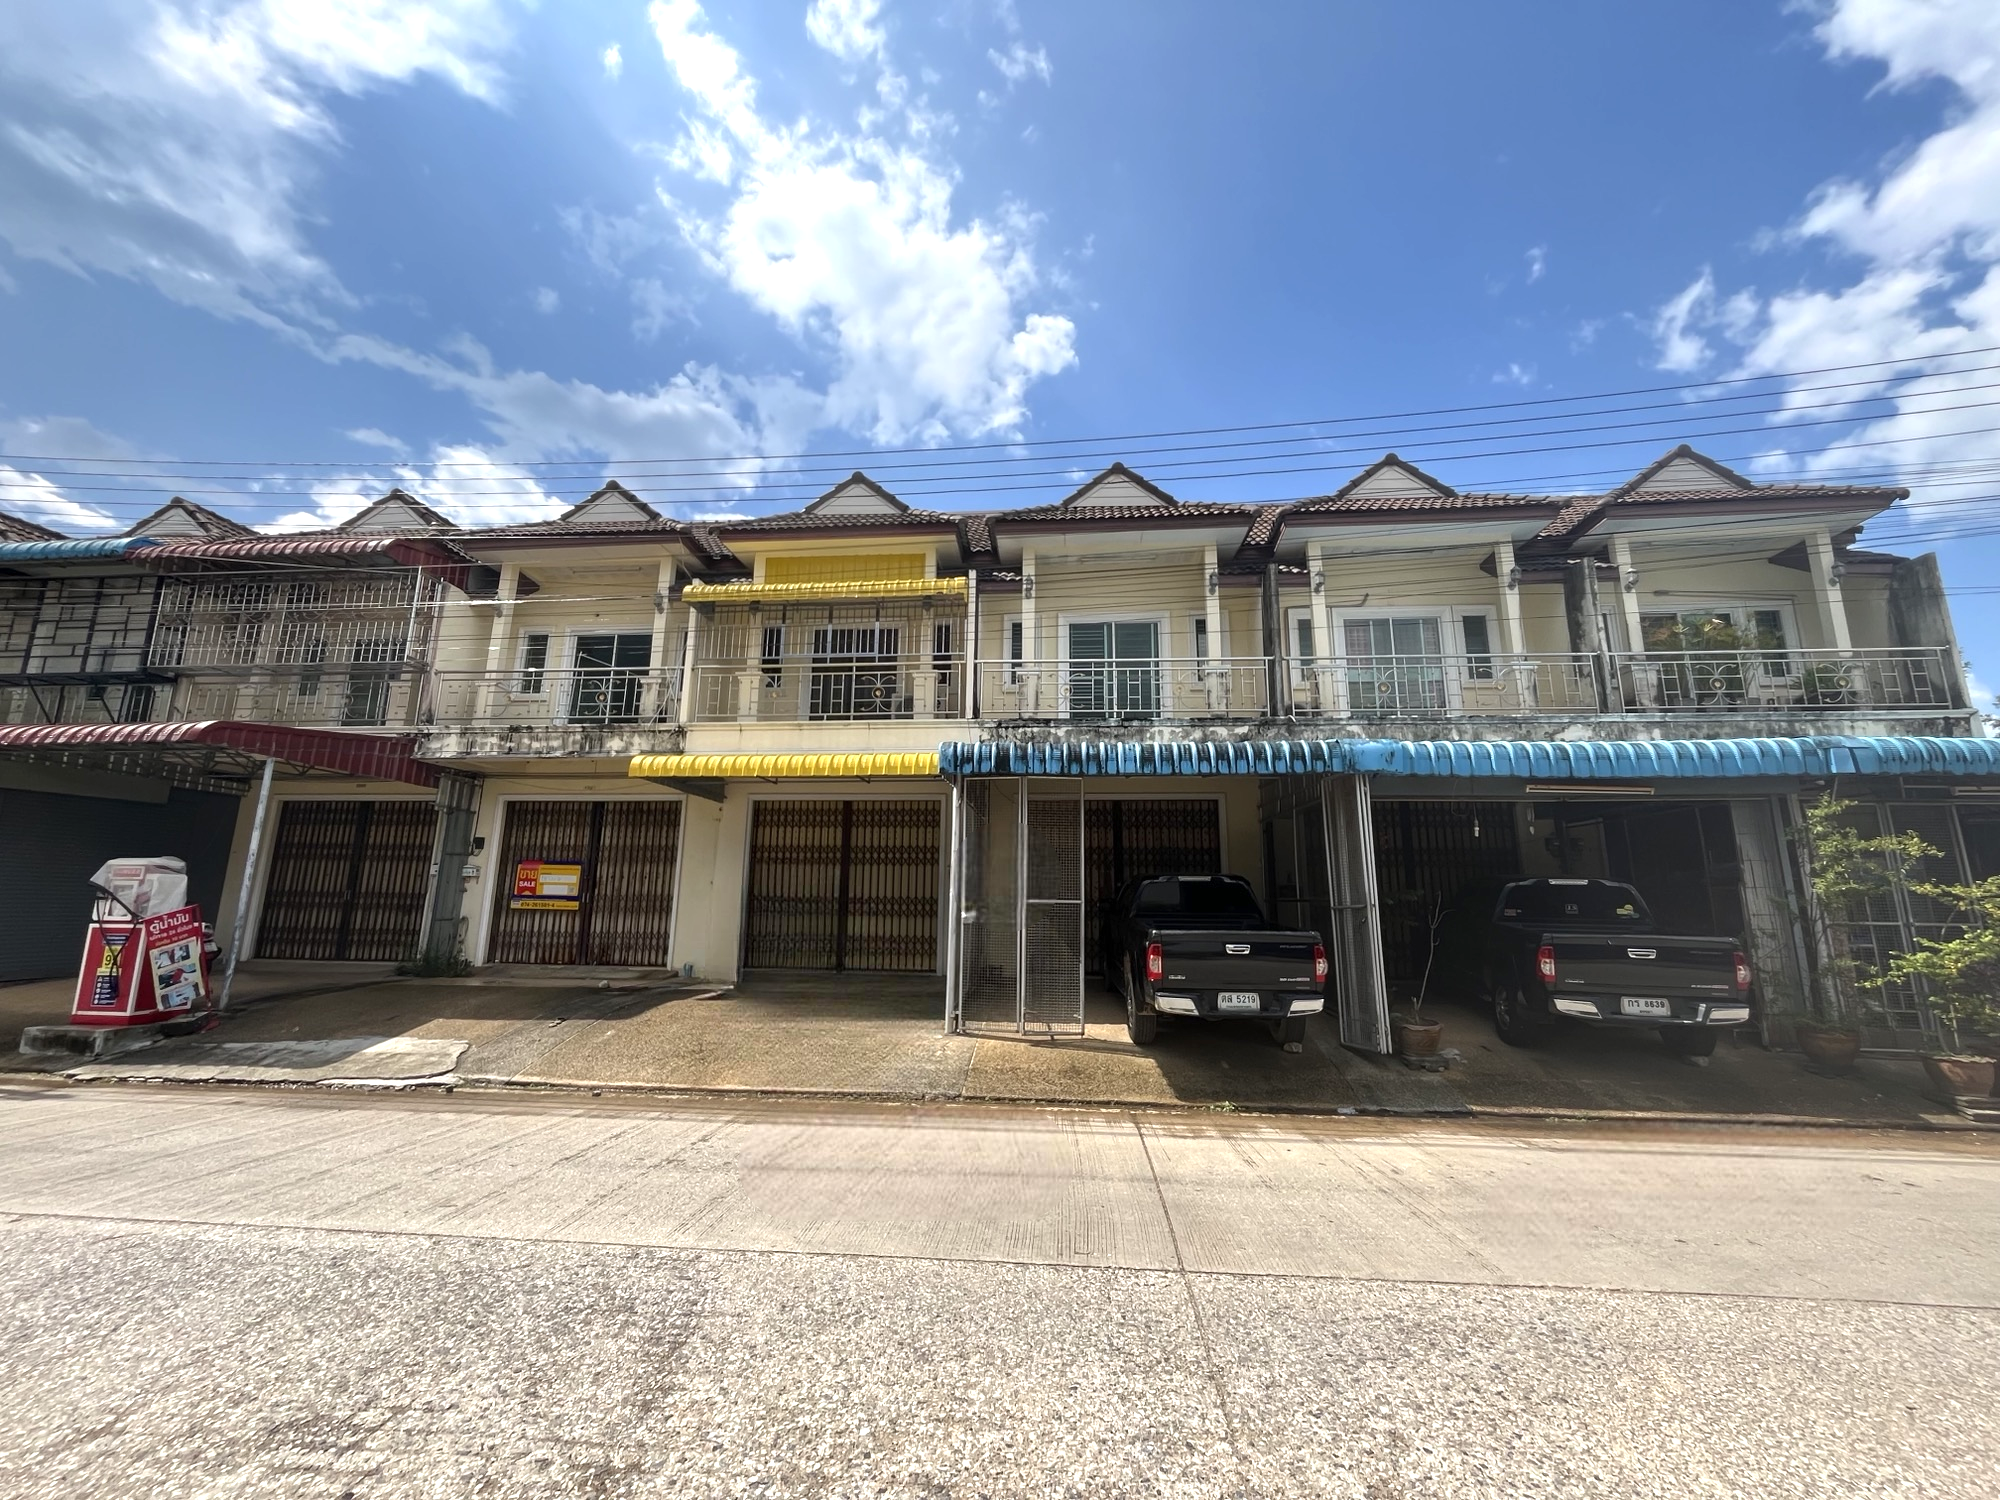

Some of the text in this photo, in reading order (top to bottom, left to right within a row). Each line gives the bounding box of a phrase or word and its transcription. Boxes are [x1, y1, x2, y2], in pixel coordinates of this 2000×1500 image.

[520, 870, 538, 879] ขาย
[150, 913, 190, 934] ตู้น้ำมัน
[1236, 994, 1256, 1004] 5219
